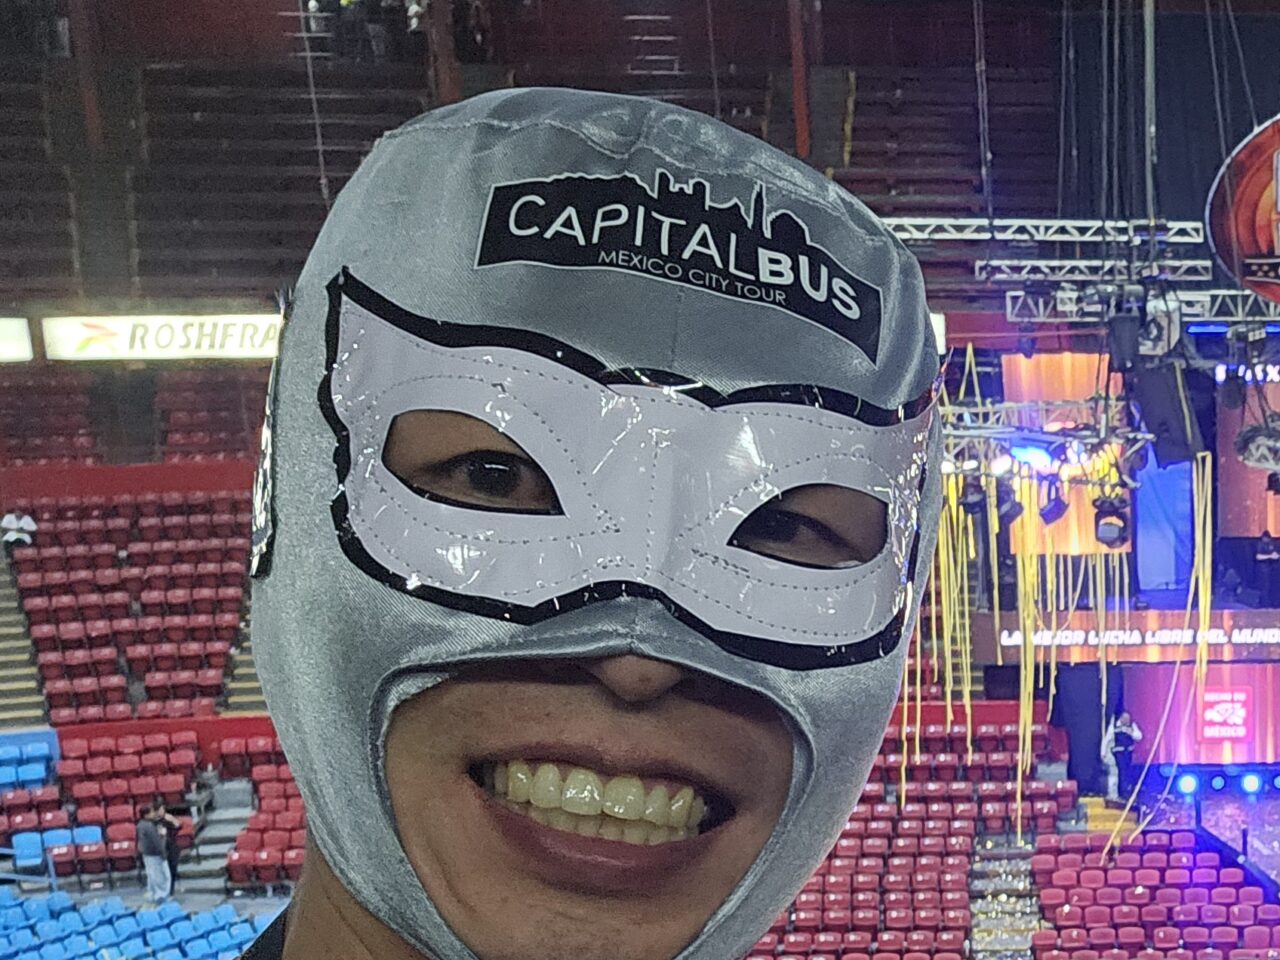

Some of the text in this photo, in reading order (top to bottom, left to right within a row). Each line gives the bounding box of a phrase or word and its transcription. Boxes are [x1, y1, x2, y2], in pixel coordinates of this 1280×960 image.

[508, 194, 862, 320] CAPITALBUS
[598, 251, 786, 306] MEXICO CITY TOUR
[129, 323, 278, 350] ROSHFRA
